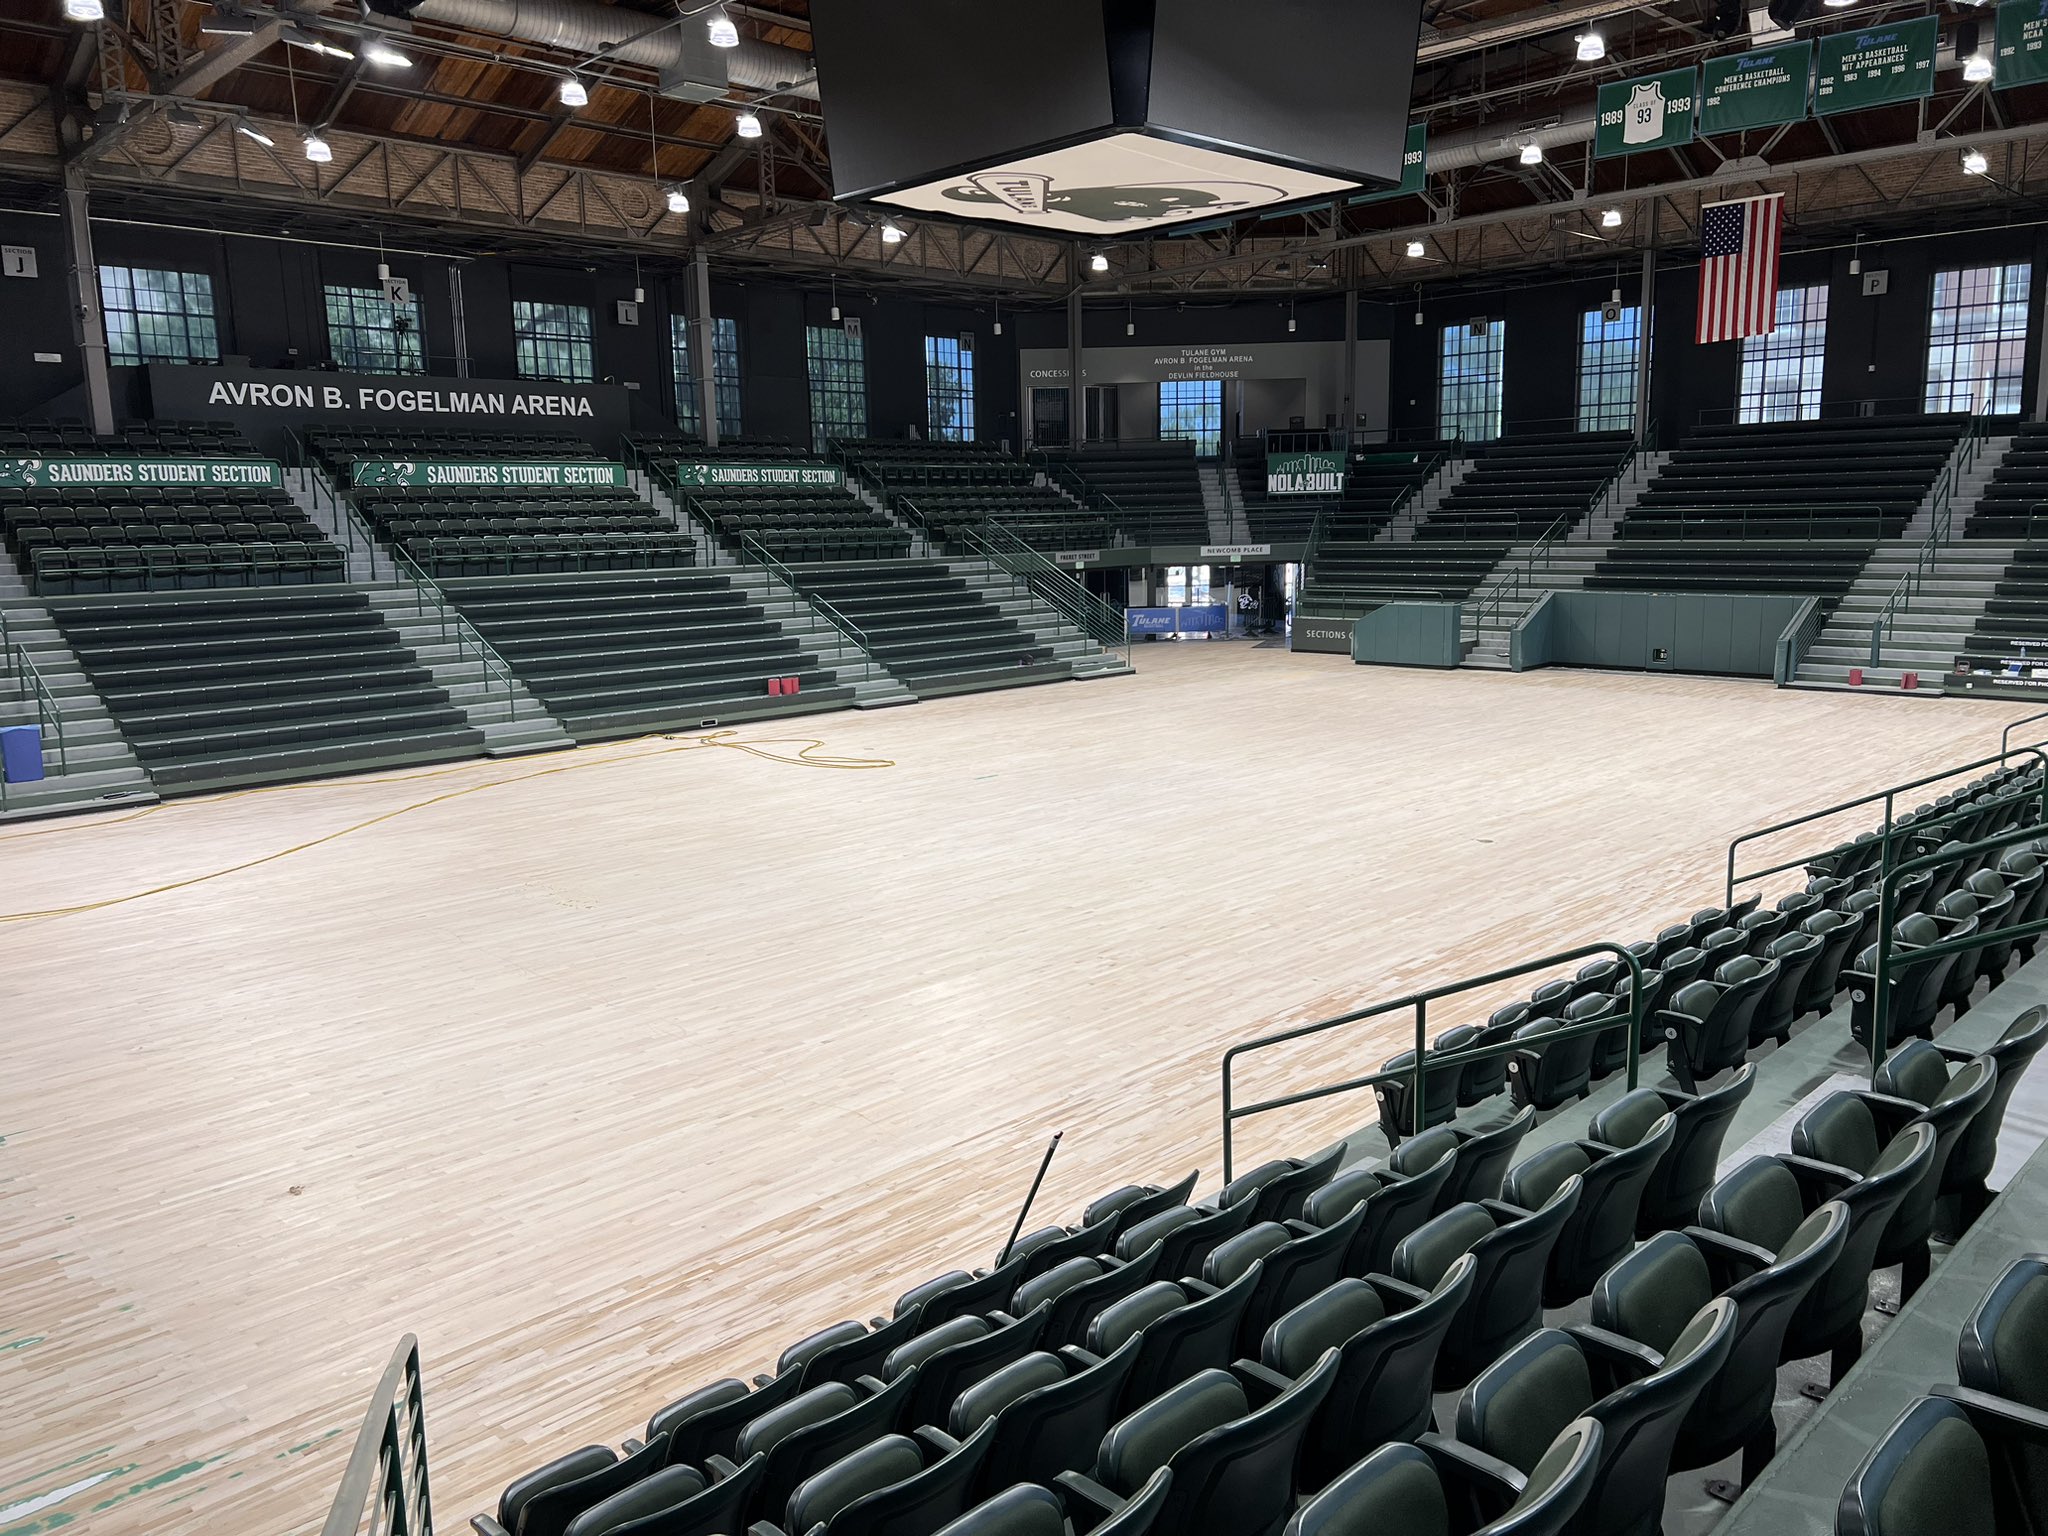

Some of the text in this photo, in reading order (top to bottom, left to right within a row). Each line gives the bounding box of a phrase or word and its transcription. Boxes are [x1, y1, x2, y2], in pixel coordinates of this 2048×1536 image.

[2023, 18, 2048, 31] MEN'S
[1855, 33, 1898, 50] TULANE
[2022, 28, 2044, 40] NCAA
[1841, 44, 1909, 63] MEN'S BASKETBALL
[2000, 41, 2042, 57] 1992 1993
[1736, 56, 1776, 72] TULANE
[1841, 53, 1904, 72] NIT APPEARANCES
[1867, 68, 1881, 78] 1994
[1915, 60, 1930, 70] 1997
[1723, 66, 1784, 85] MEN'S BASKETBALL
[1714, 74, 1791, 94] CONFERENCE CHAMPIONS
[1633, 101, 1649, 109] CLASS
[1667, 96, 1691, 114] 1993
[1600, 109, 1623, 127] 1989
[1637, 107, 1652, 125] 93
[1404, 150, 1423, 166] 1993
[16, 256, 24, 273] J
[391, 286, 403, 301] K
[1870, 280, 1880, 292] P
[625, 309, 633, 322] L
[847, 324, 858, 336] M
[1473, 323, 1483, 335] N
[1154, 357, 1178, 365] AVRON
[1189, 355, 1228, 364] FOGELMAN
[1229, 355, 1254, 363] ARENA
[1030, 369, 1087, 378] CONCESSIS
[1168, 370, 1239, 380] DEVLIN FIELDHOUSE
[208, 381, 594, 417] AVRON B. FOGELMAN ARENA
[48, 463, 272, 483] SAUNDERS STUDENT SECTION
[427, 465, 614, 484] SAUNDERS STUDENT SECTION
[711, 468, 835, 483] SAUNDERS STUDENT SECTION
[1268, 474, 1304, 492] NOLA
[1132, 614, 1171, 626] TULANE
[1306, 629, 1346, 639] SECTIONS
